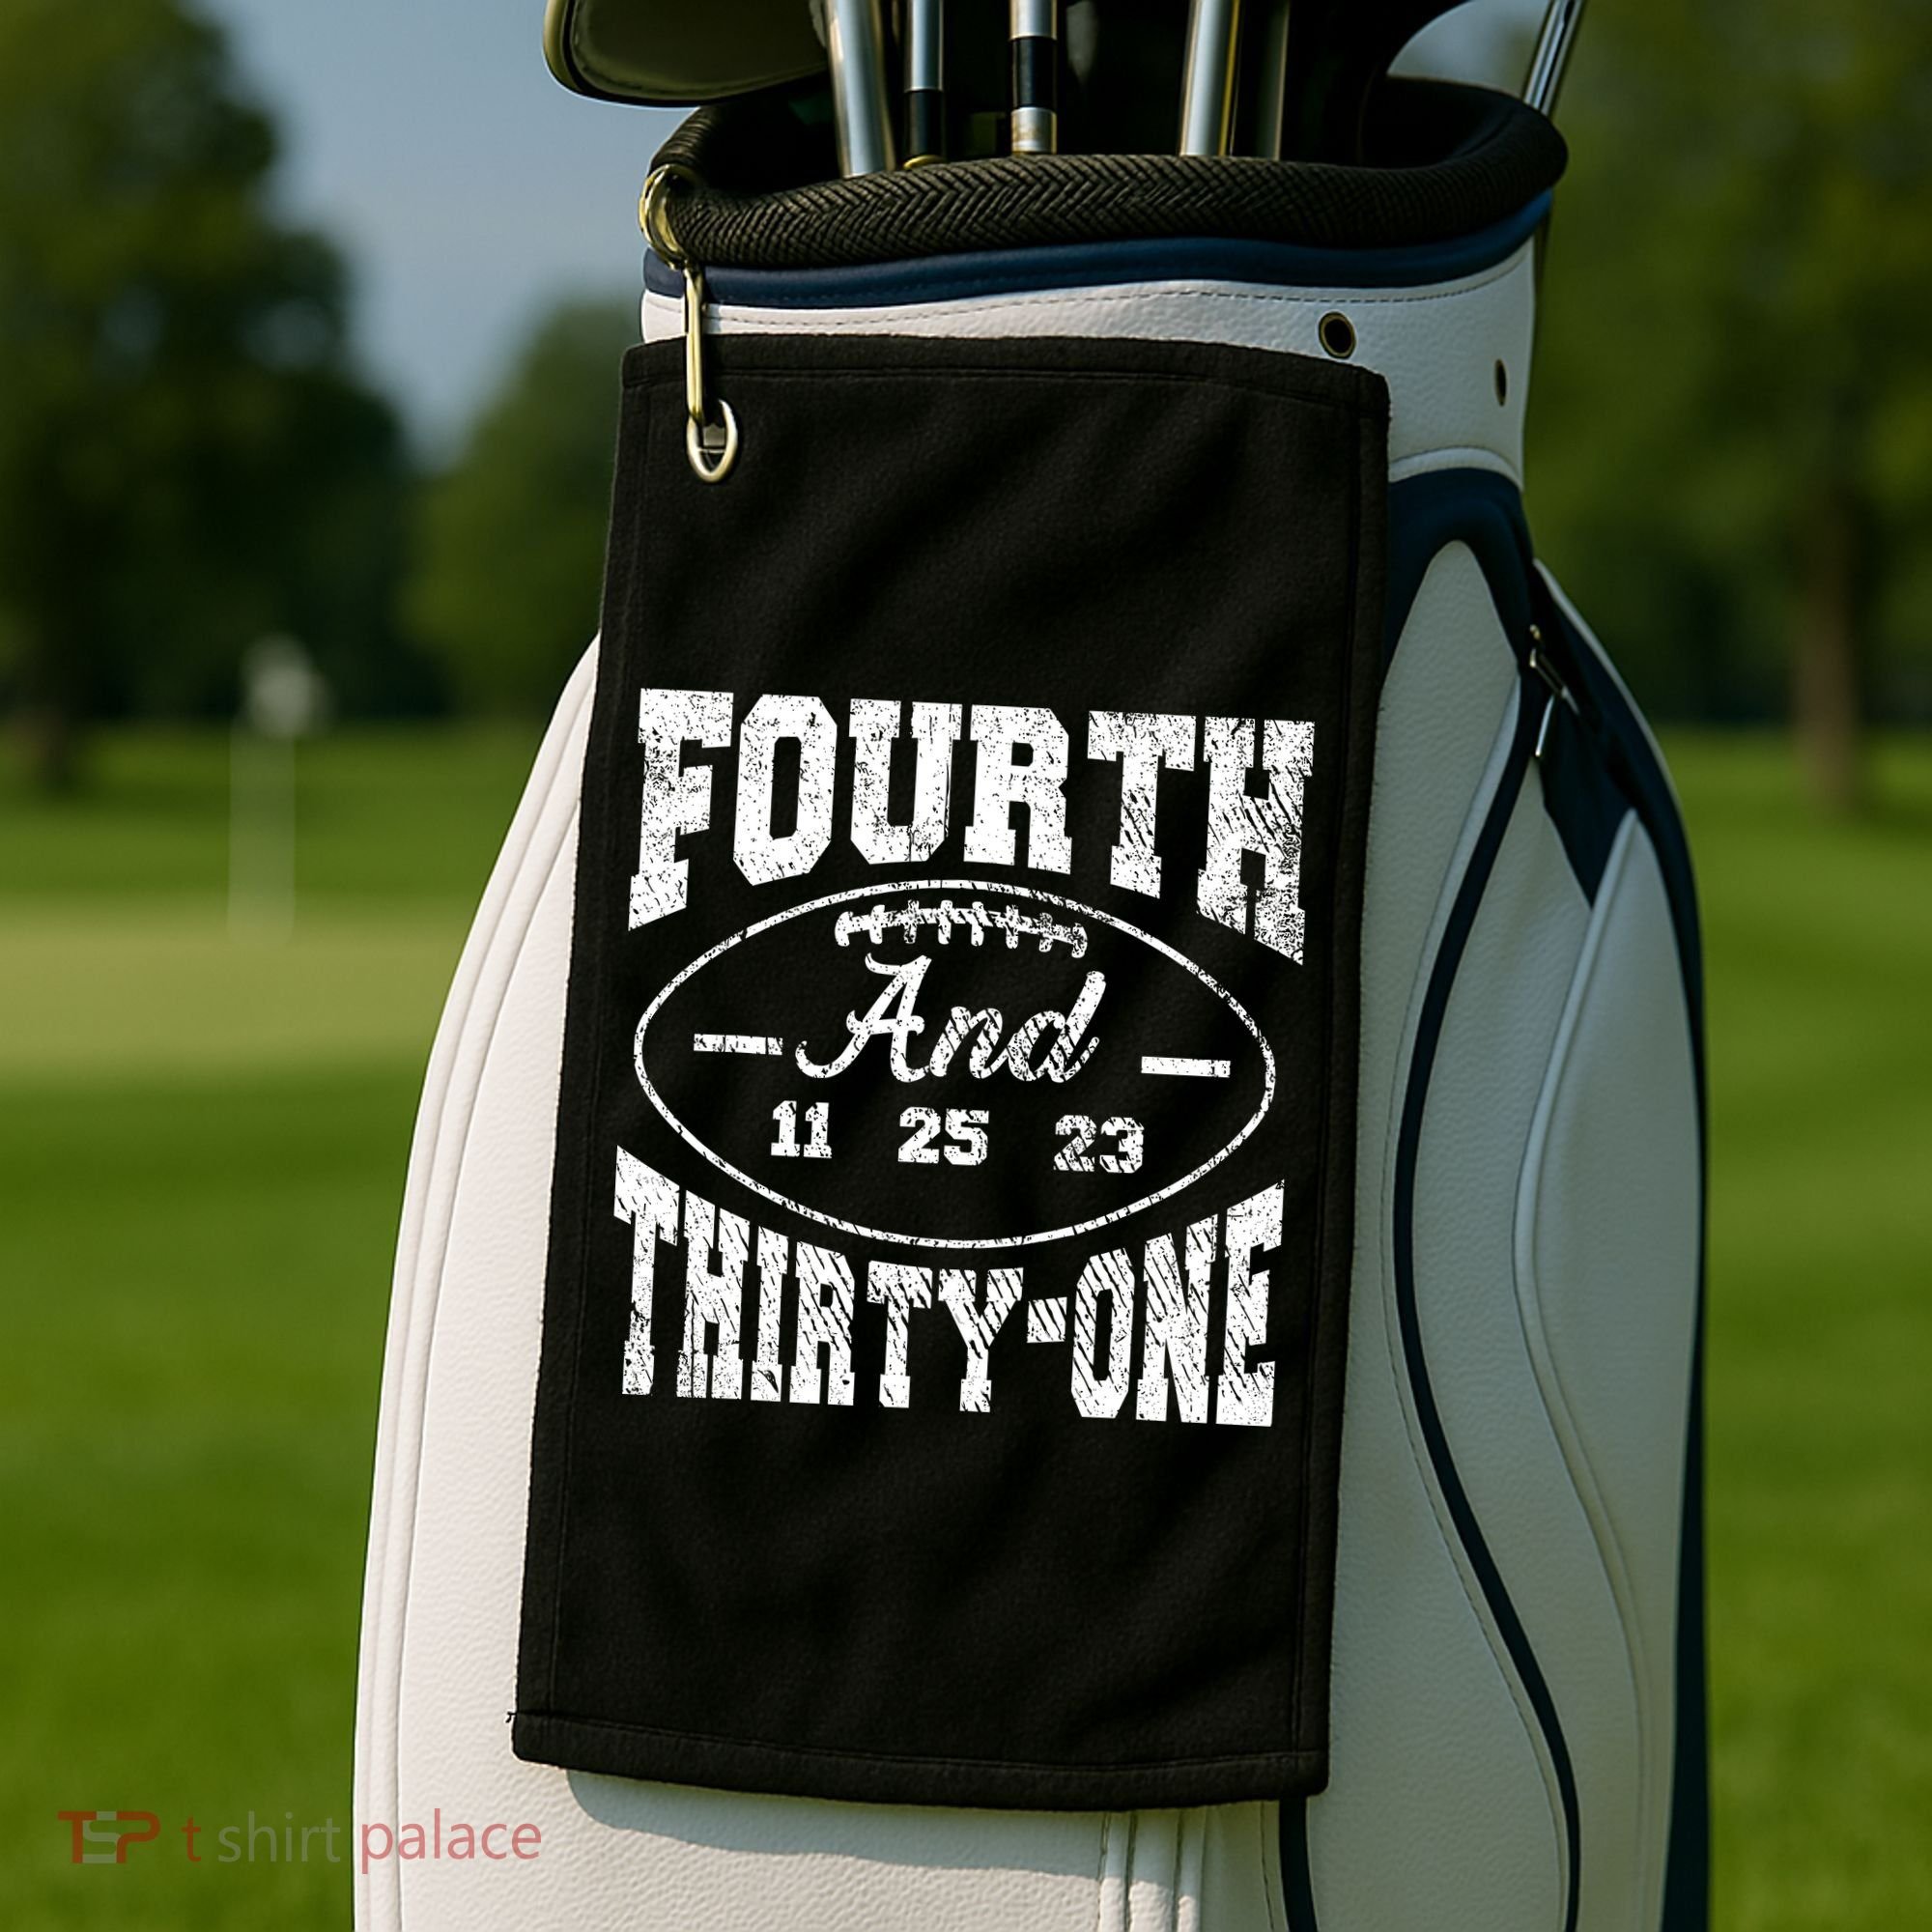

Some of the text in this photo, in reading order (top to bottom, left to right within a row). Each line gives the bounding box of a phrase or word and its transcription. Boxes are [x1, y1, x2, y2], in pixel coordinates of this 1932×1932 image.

[628, 688, 1316, 966] FOURTH
[795, 952, 1107, 1084] And
[770, 1099, 1145, 1174] 11 25 23
[613, 1145, 1285, 1428] THIRTY-ONE
